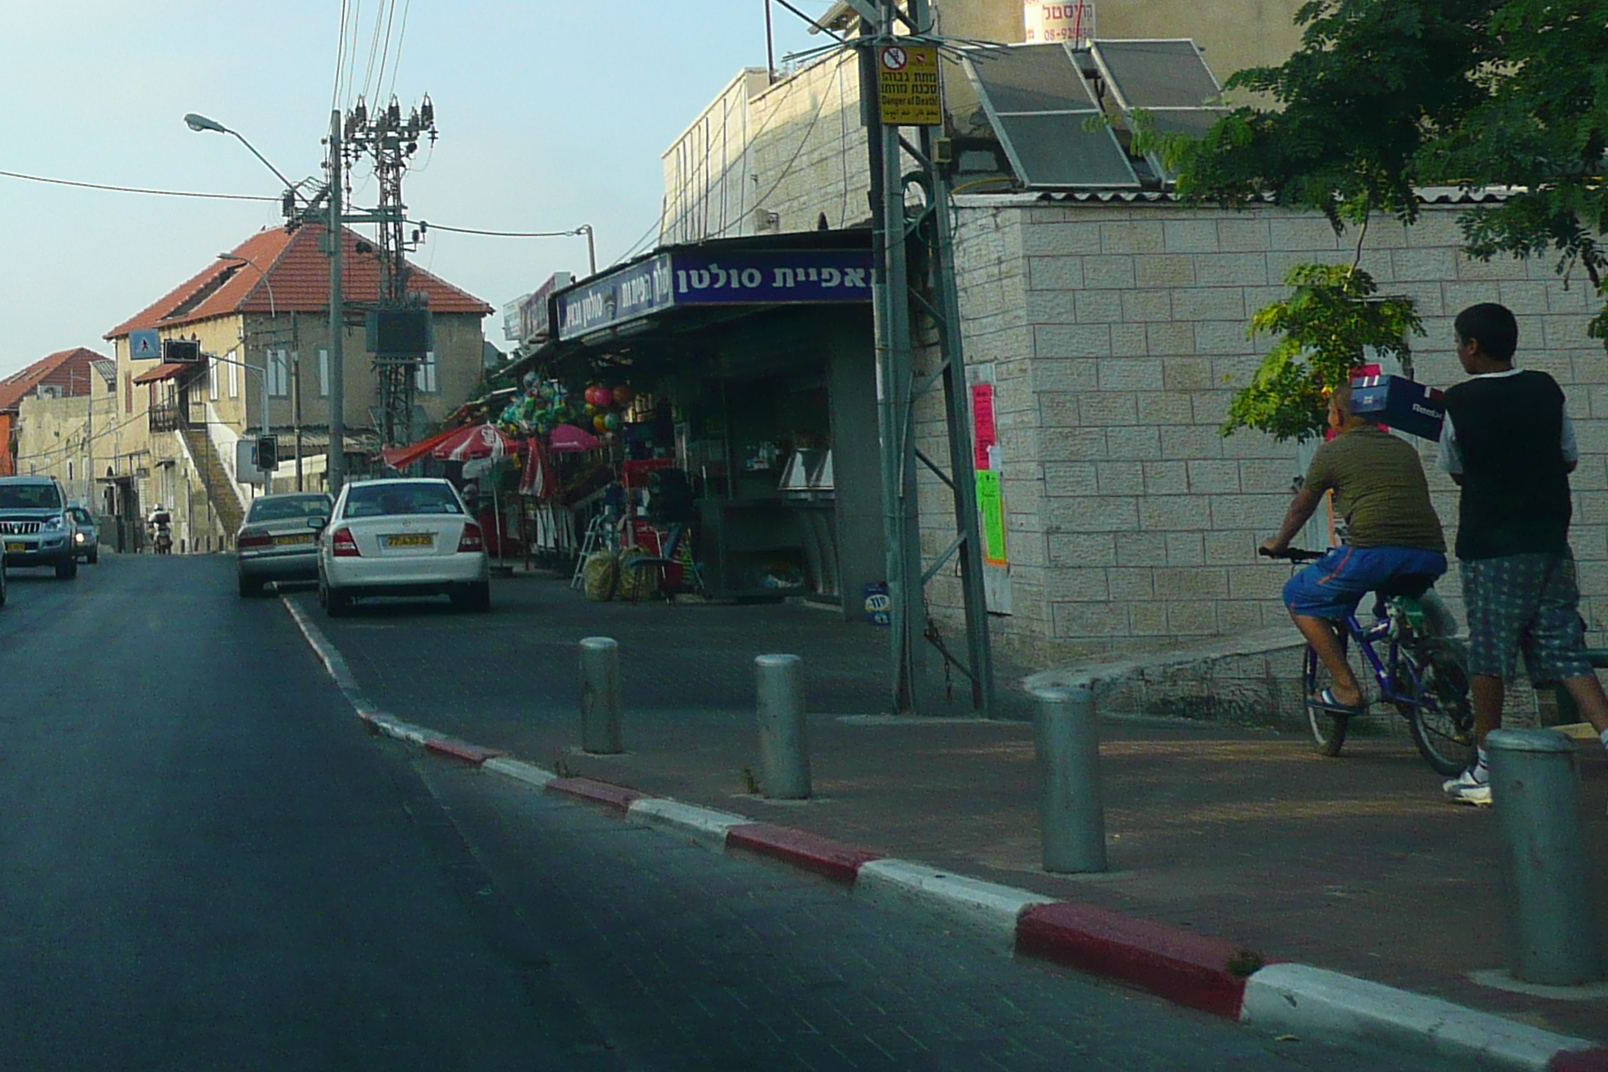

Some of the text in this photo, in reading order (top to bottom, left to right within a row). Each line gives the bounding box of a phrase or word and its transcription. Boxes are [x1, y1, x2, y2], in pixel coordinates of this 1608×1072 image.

[915, 72, 937, 82] מתח
[912, 83, 937, 94] סכנת
[882, 95, 905, 107] Danger
[915, 96, 938, 106] Death!
[677, 263, 875, 294] אפיית סולטן
